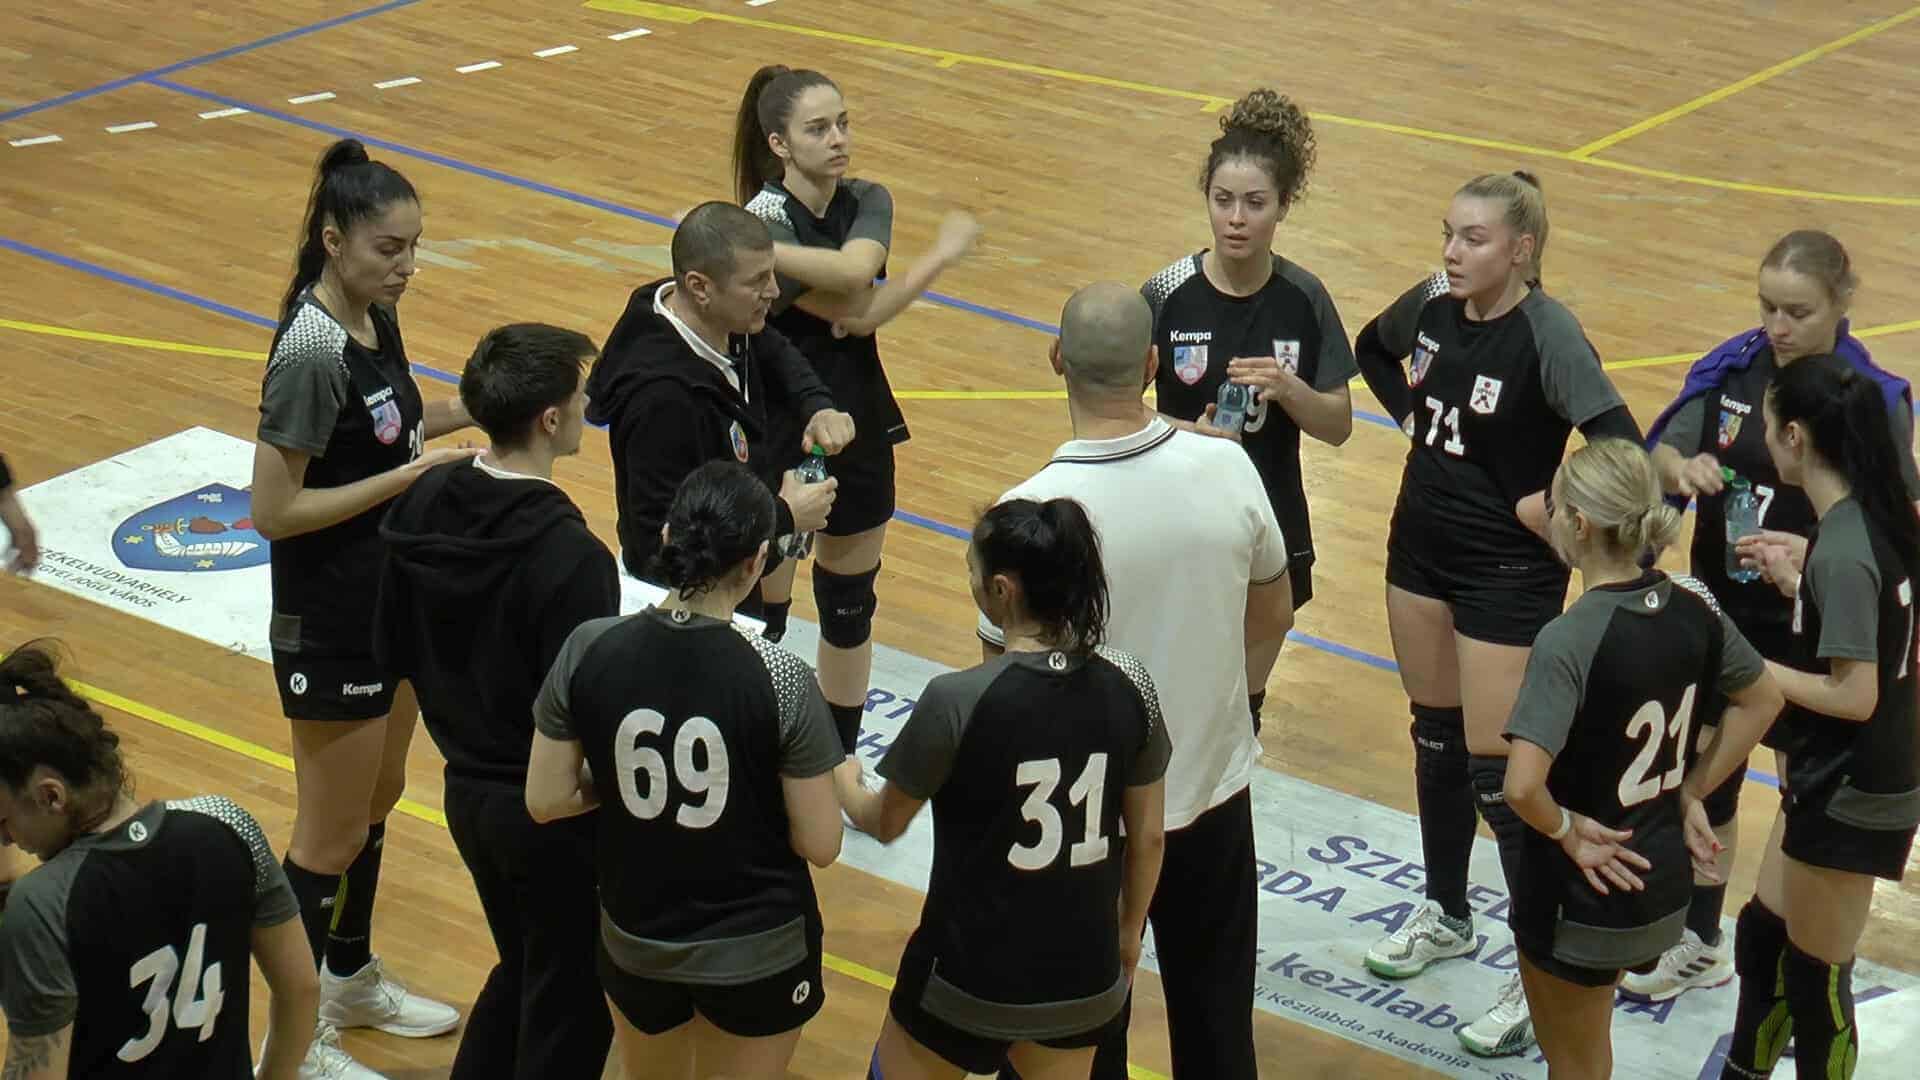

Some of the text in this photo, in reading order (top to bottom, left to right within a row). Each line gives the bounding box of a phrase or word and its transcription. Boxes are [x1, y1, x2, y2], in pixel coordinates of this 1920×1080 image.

[1170, 330, 1212, 344] Kempa
[1425, 395, 1465, 456] 71
[614, 708, 729, 829] 69
[1618, 682, 1697, 808] 21
[1007, 752, 1109, 871] 31
[116, 923, 225, 1063] 34
